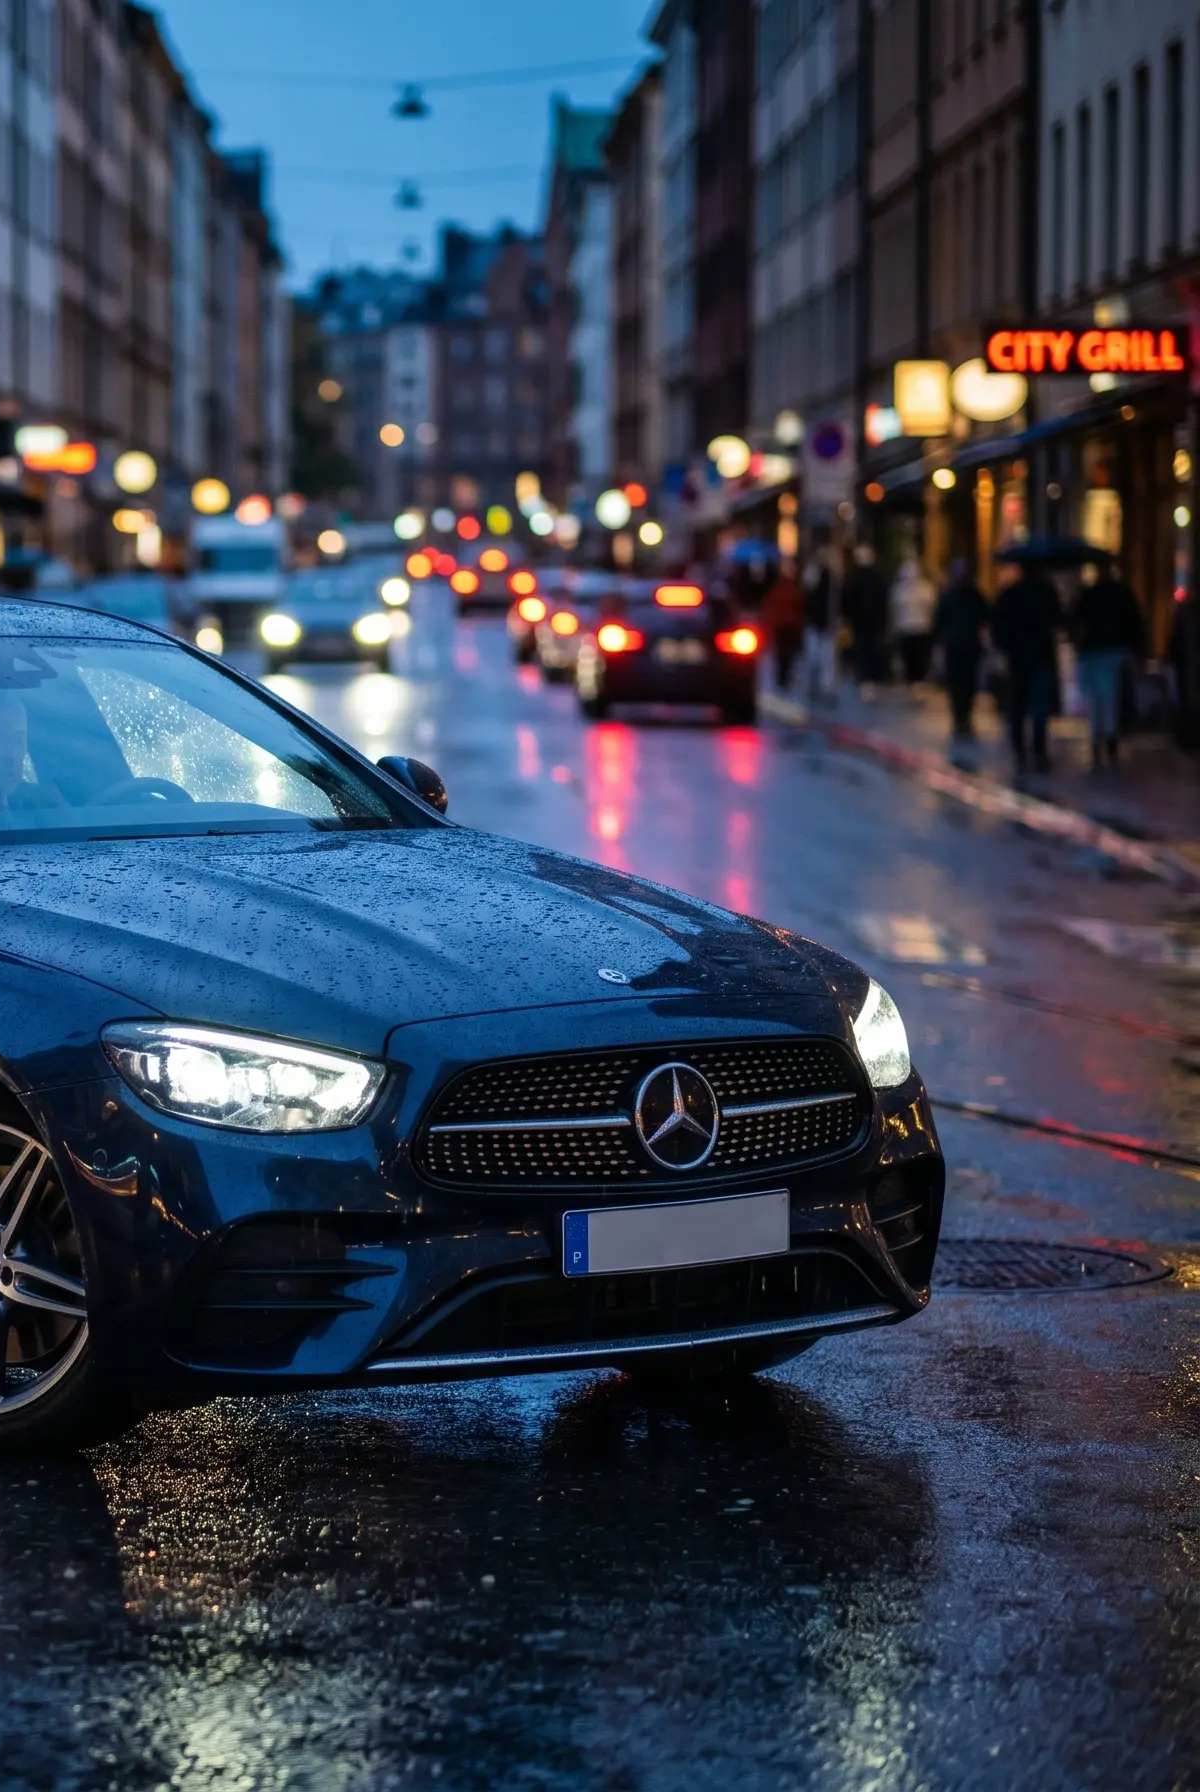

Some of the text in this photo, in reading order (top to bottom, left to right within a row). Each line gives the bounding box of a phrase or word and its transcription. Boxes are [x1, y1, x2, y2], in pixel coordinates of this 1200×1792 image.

[987, 330, 1184, 373] CITY GRILL
[573, 1251, 582, 1264] P
